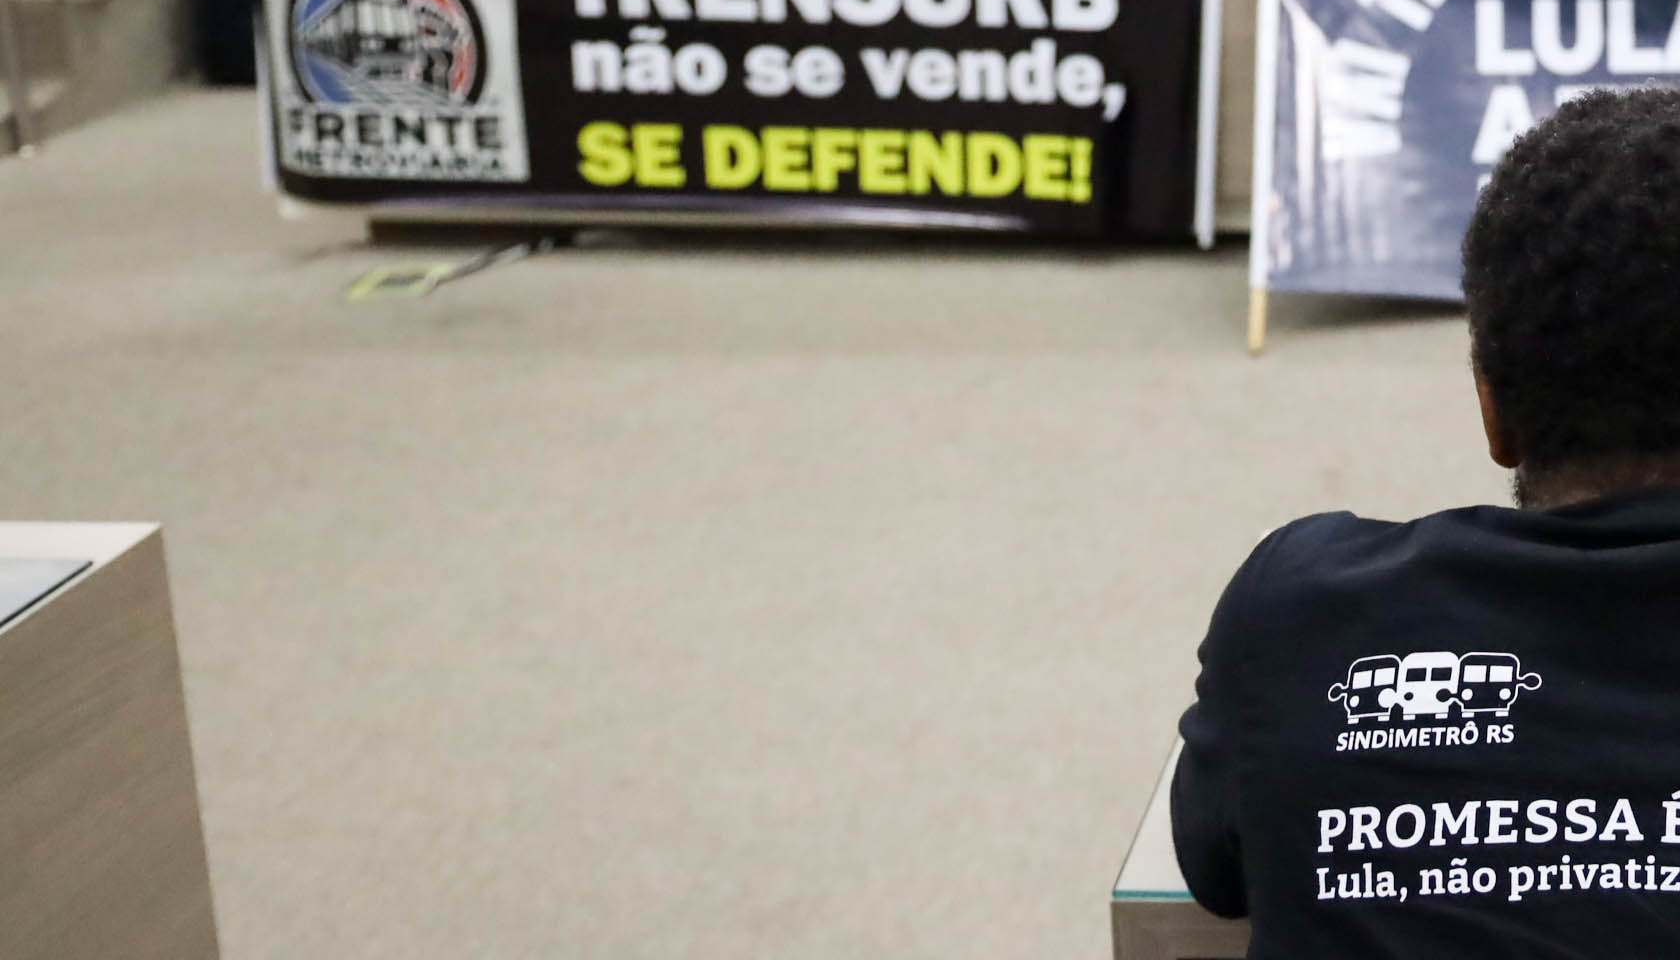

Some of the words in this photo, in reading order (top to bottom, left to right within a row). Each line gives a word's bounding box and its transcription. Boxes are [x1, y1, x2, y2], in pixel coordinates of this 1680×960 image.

[571, 26, 727, 95] não
[744, 45, 844, 97] se
[860, 39, 1127, 120] vende,
[288, 107, 504, 149] FRENTE
[1472, 84, 1540, 165] A
[577, 121, 685, 187] SE
[703, 126, 1093, 202] DEFENDE!
[1486, 724, 1515, 744] RS
[1317, 798, 1645, 853] PROMESSA
[1316, 862, 1408, 903] Lula,
[1418, 857, 1497, 896] não
